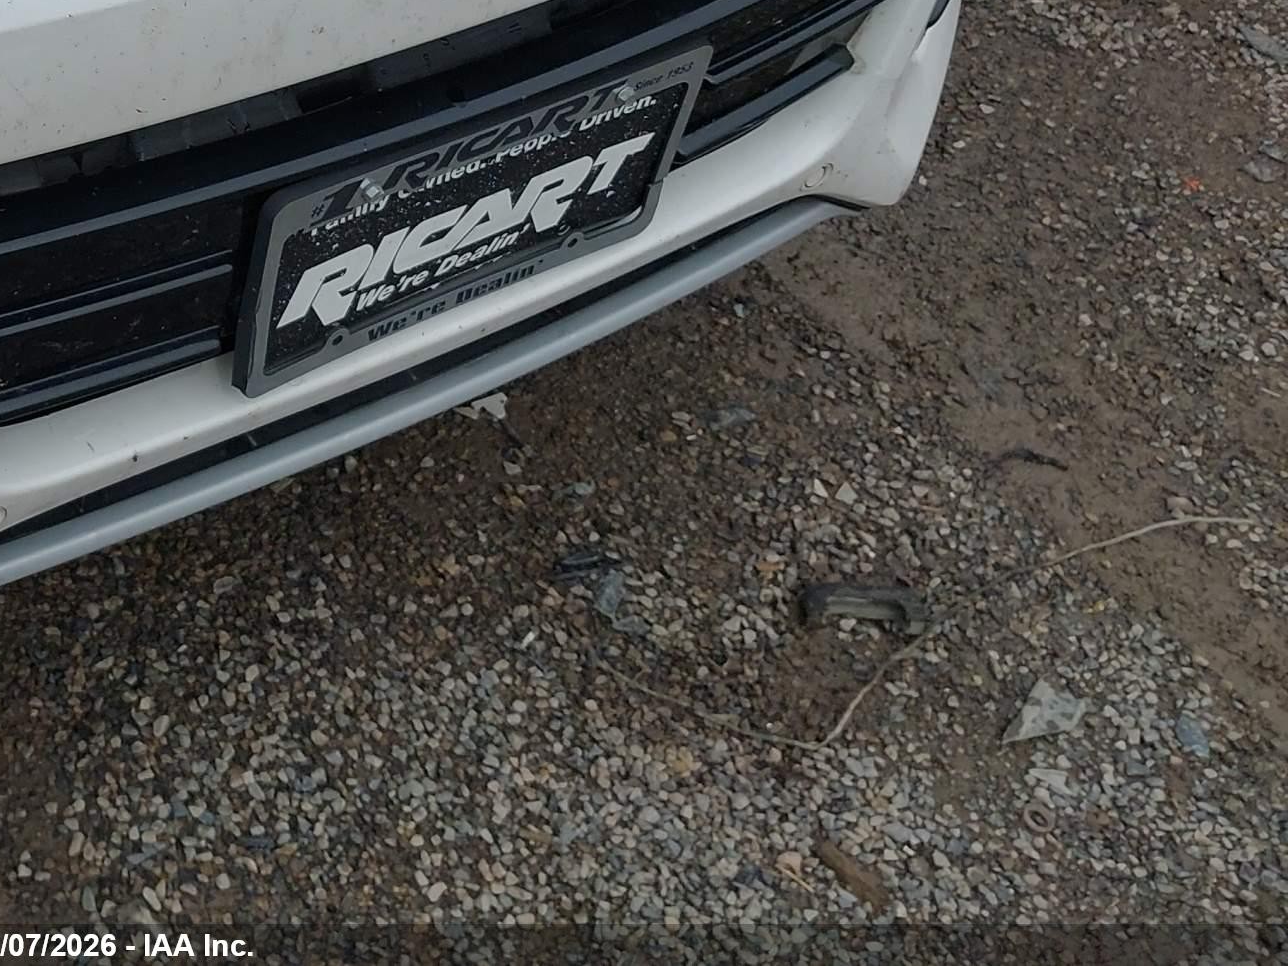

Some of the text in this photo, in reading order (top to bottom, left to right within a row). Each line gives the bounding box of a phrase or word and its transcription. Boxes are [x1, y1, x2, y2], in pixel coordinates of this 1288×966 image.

[310, 194, 391, 237] amiy
[495, 130, 572, 165] Peop
[381, 79, 630, 191] RICART
[277, 132, 656, 330] RICART
[355, 222, 531, 312] We're Dealin'
[367, 300, 447, 342] We're
